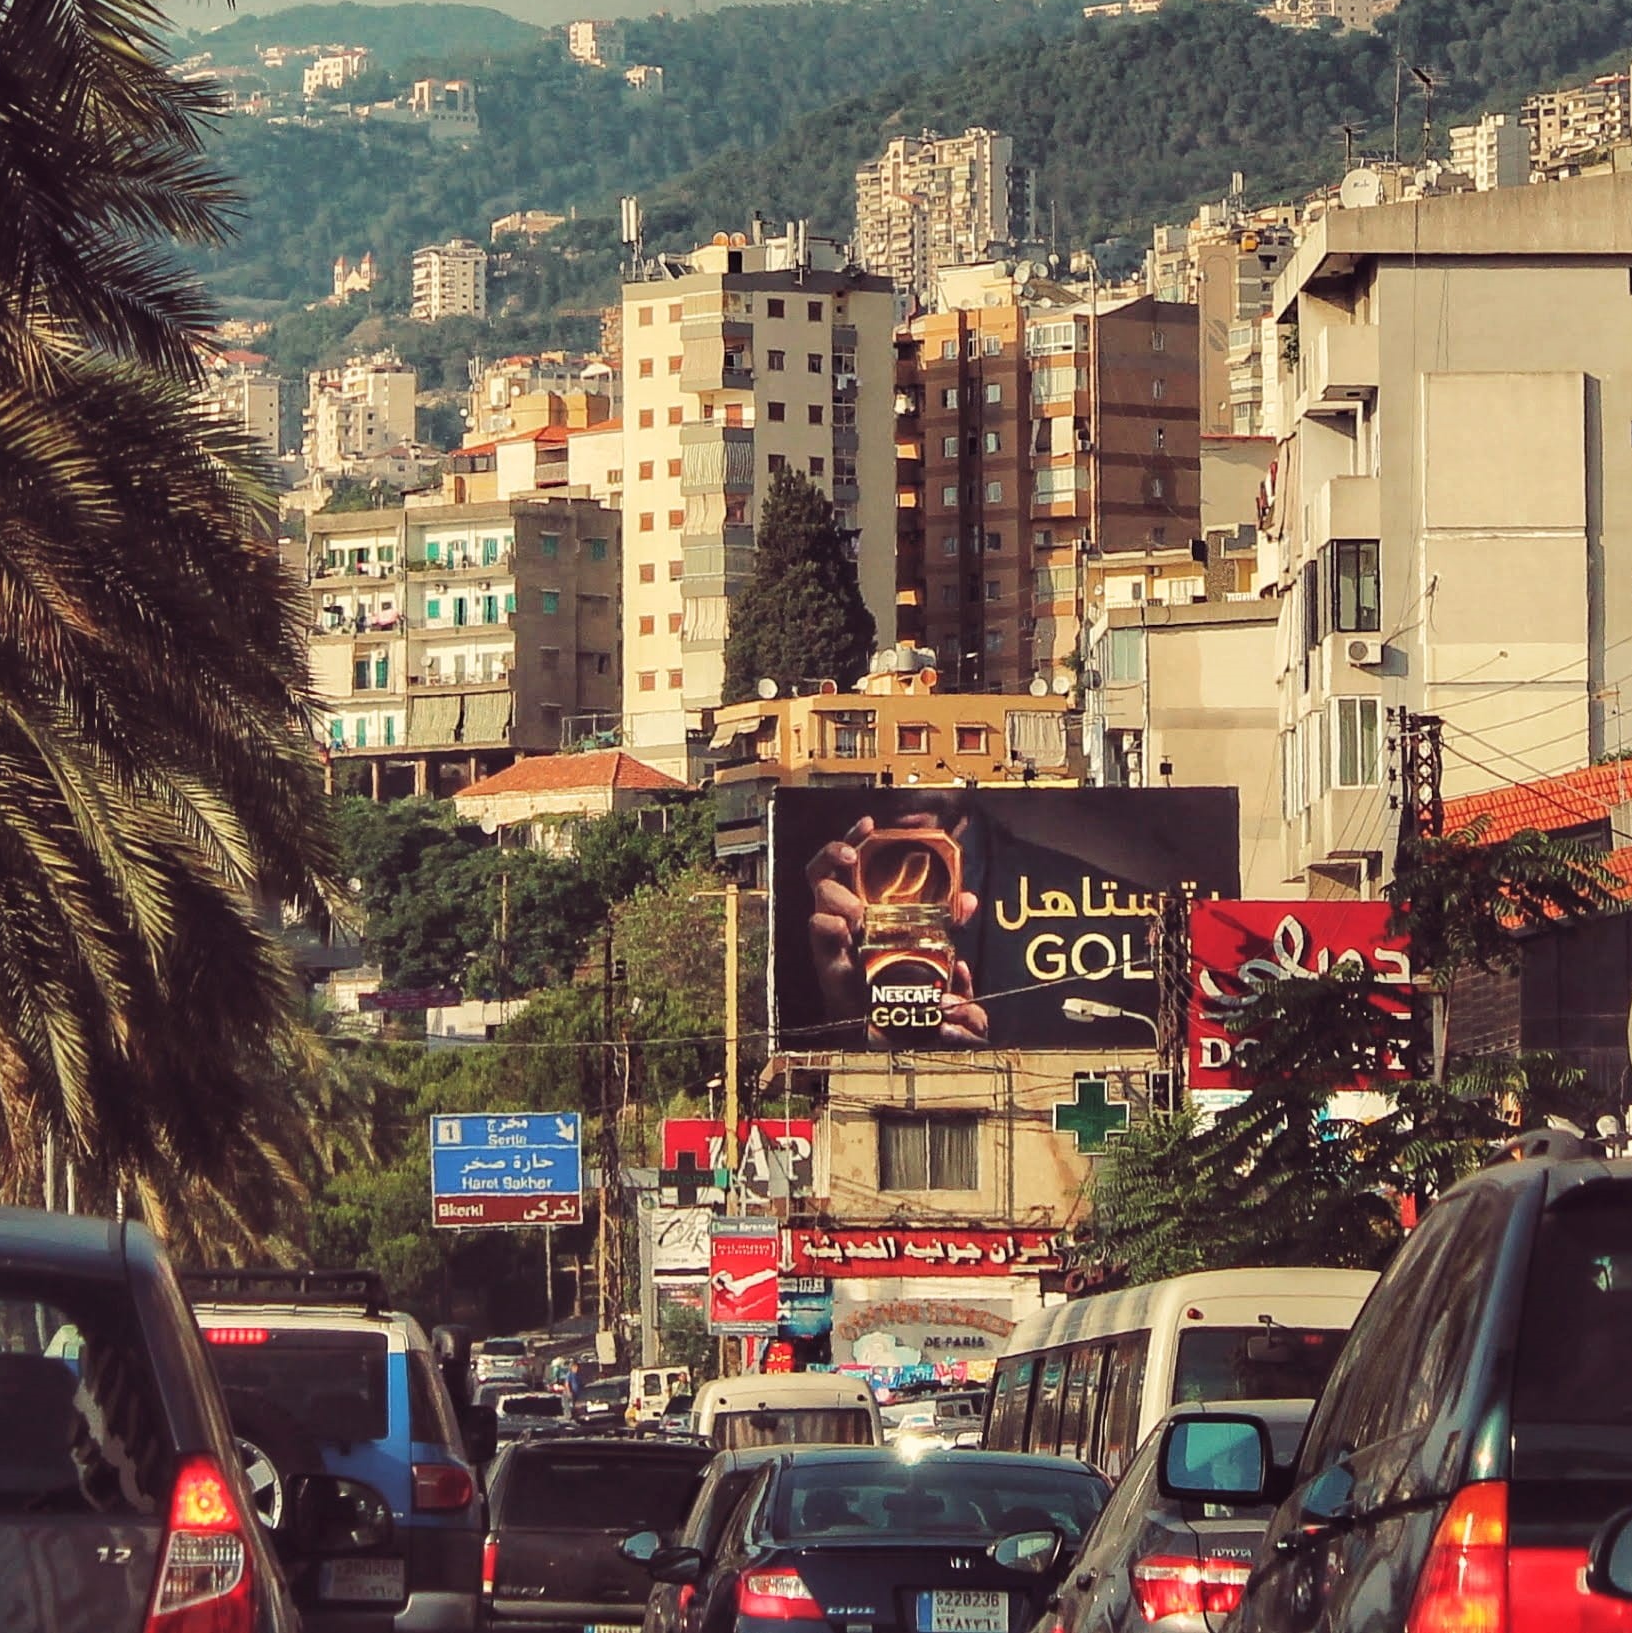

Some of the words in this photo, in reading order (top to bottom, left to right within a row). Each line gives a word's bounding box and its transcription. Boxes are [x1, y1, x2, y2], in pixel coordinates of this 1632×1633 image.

[1024, 933, 1189, 981] GOL
[871, 1005, 943, 1028] GOLD
[460, 1154, 506, 1174] صخر
[513, 1153, 555, 1173] حارة
